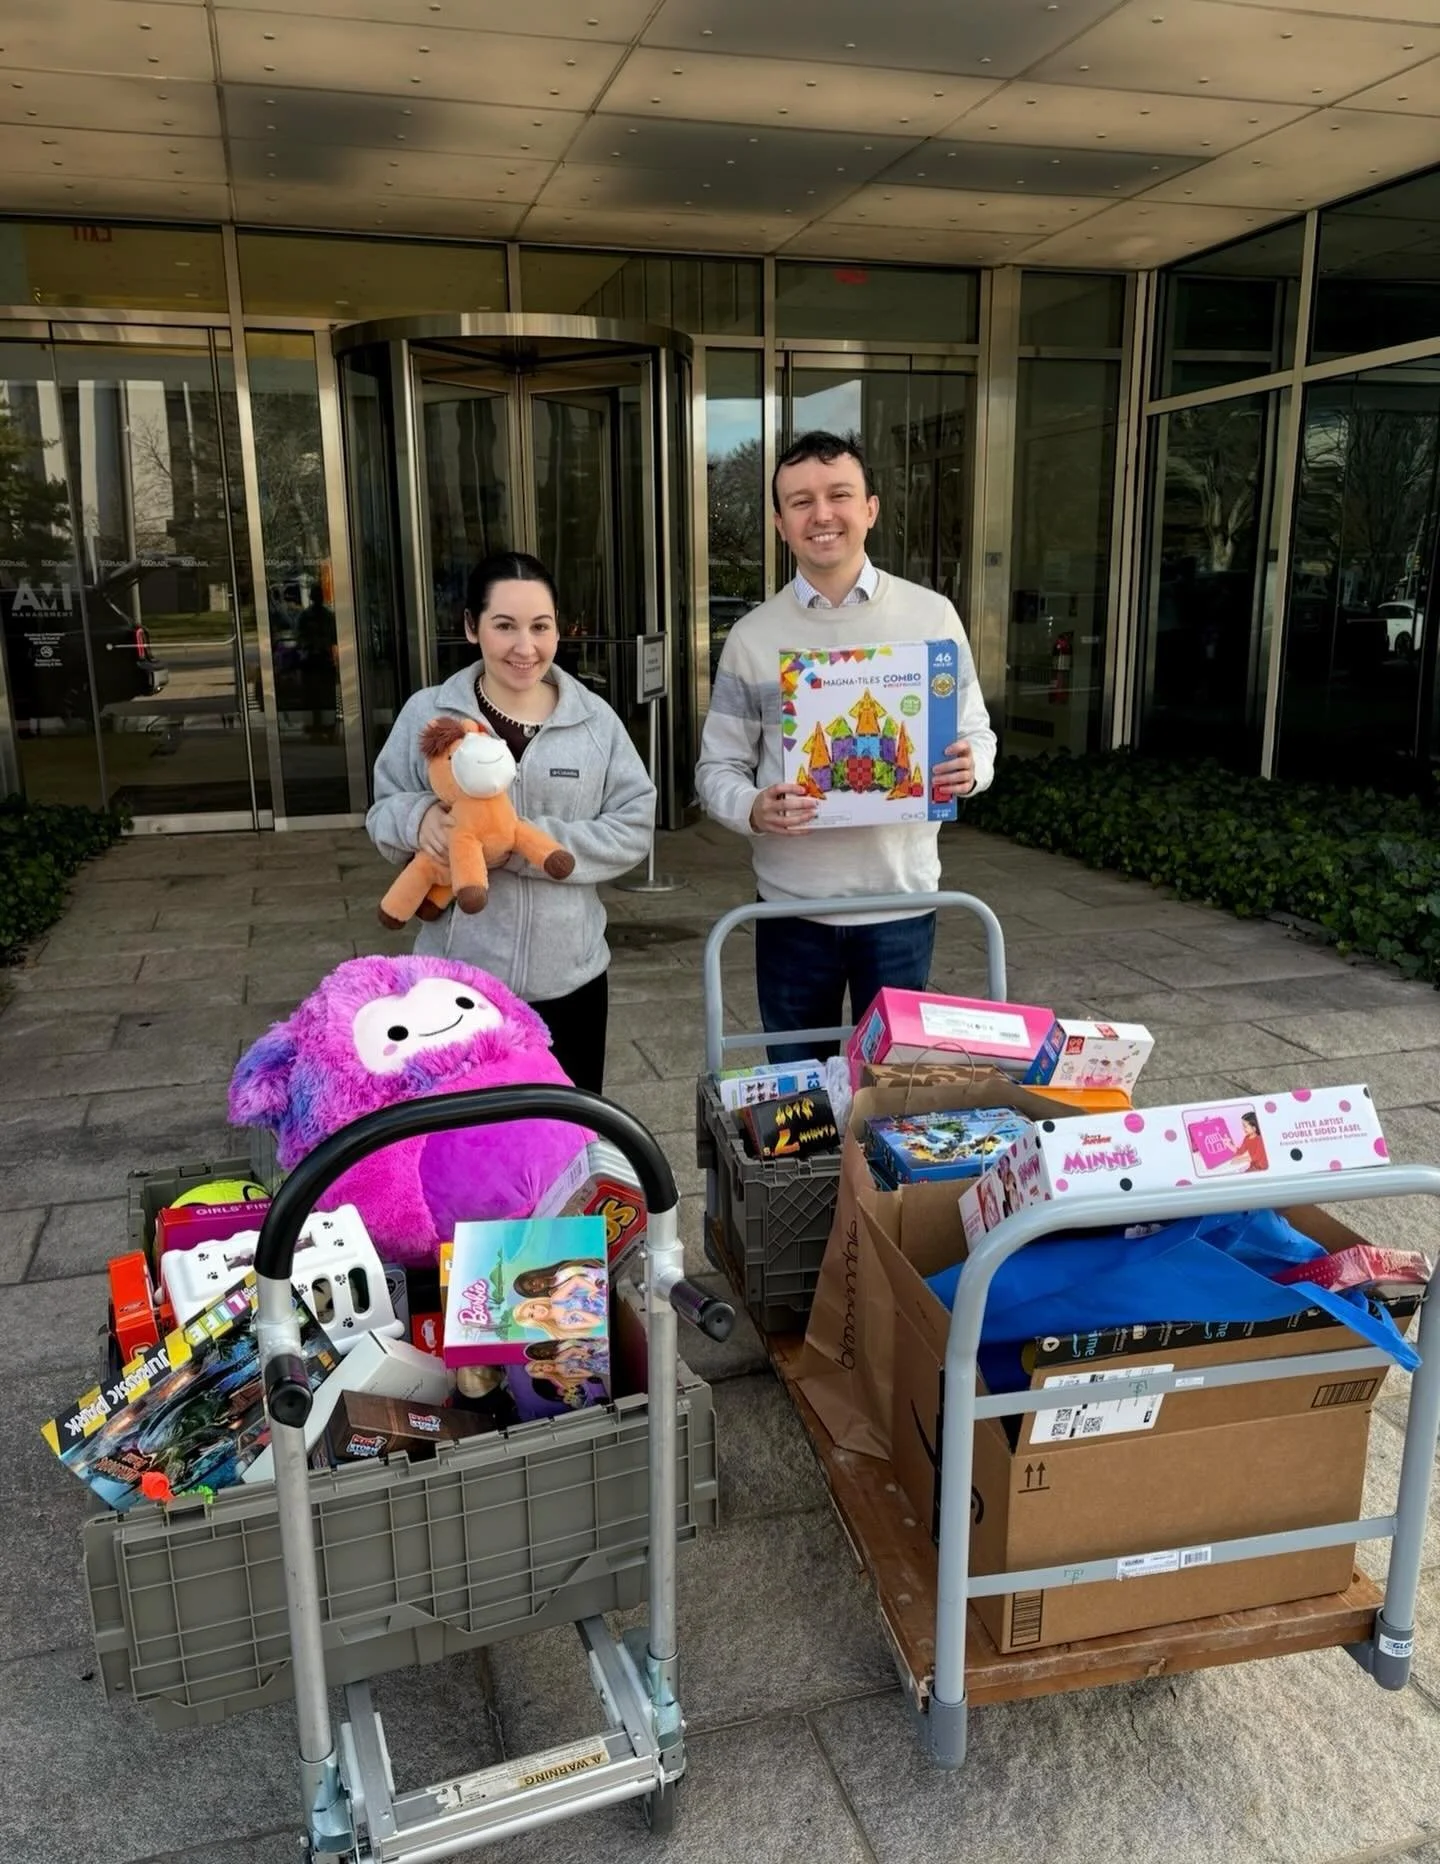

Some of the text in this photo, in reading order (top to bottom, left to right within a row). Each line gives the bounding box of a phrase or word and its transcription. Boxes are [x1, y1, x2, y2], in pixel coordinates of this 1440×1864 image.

[935, 652, 952, 663] 46
[883, 673, 921, 684] COMBO
[807, 1072, 820, 1089] 13
[1282, 1123, 1362, 1140] DOUBLE SIDED EASEL
[1294, 1116, 1344, 1130] LITTLE ARTIST
[1063, 1149, 1138, 1172] MINNIE
[196, 1203, 271, 1216] GIRLS' FIR
[458, 1279, 489, 1326] Barbie
[188, 1293, 247, 1344] LIFE
[64, 1348, 171, 1437] JURASSIC PARK
[523, 1757, 590, 1787] WARNING
